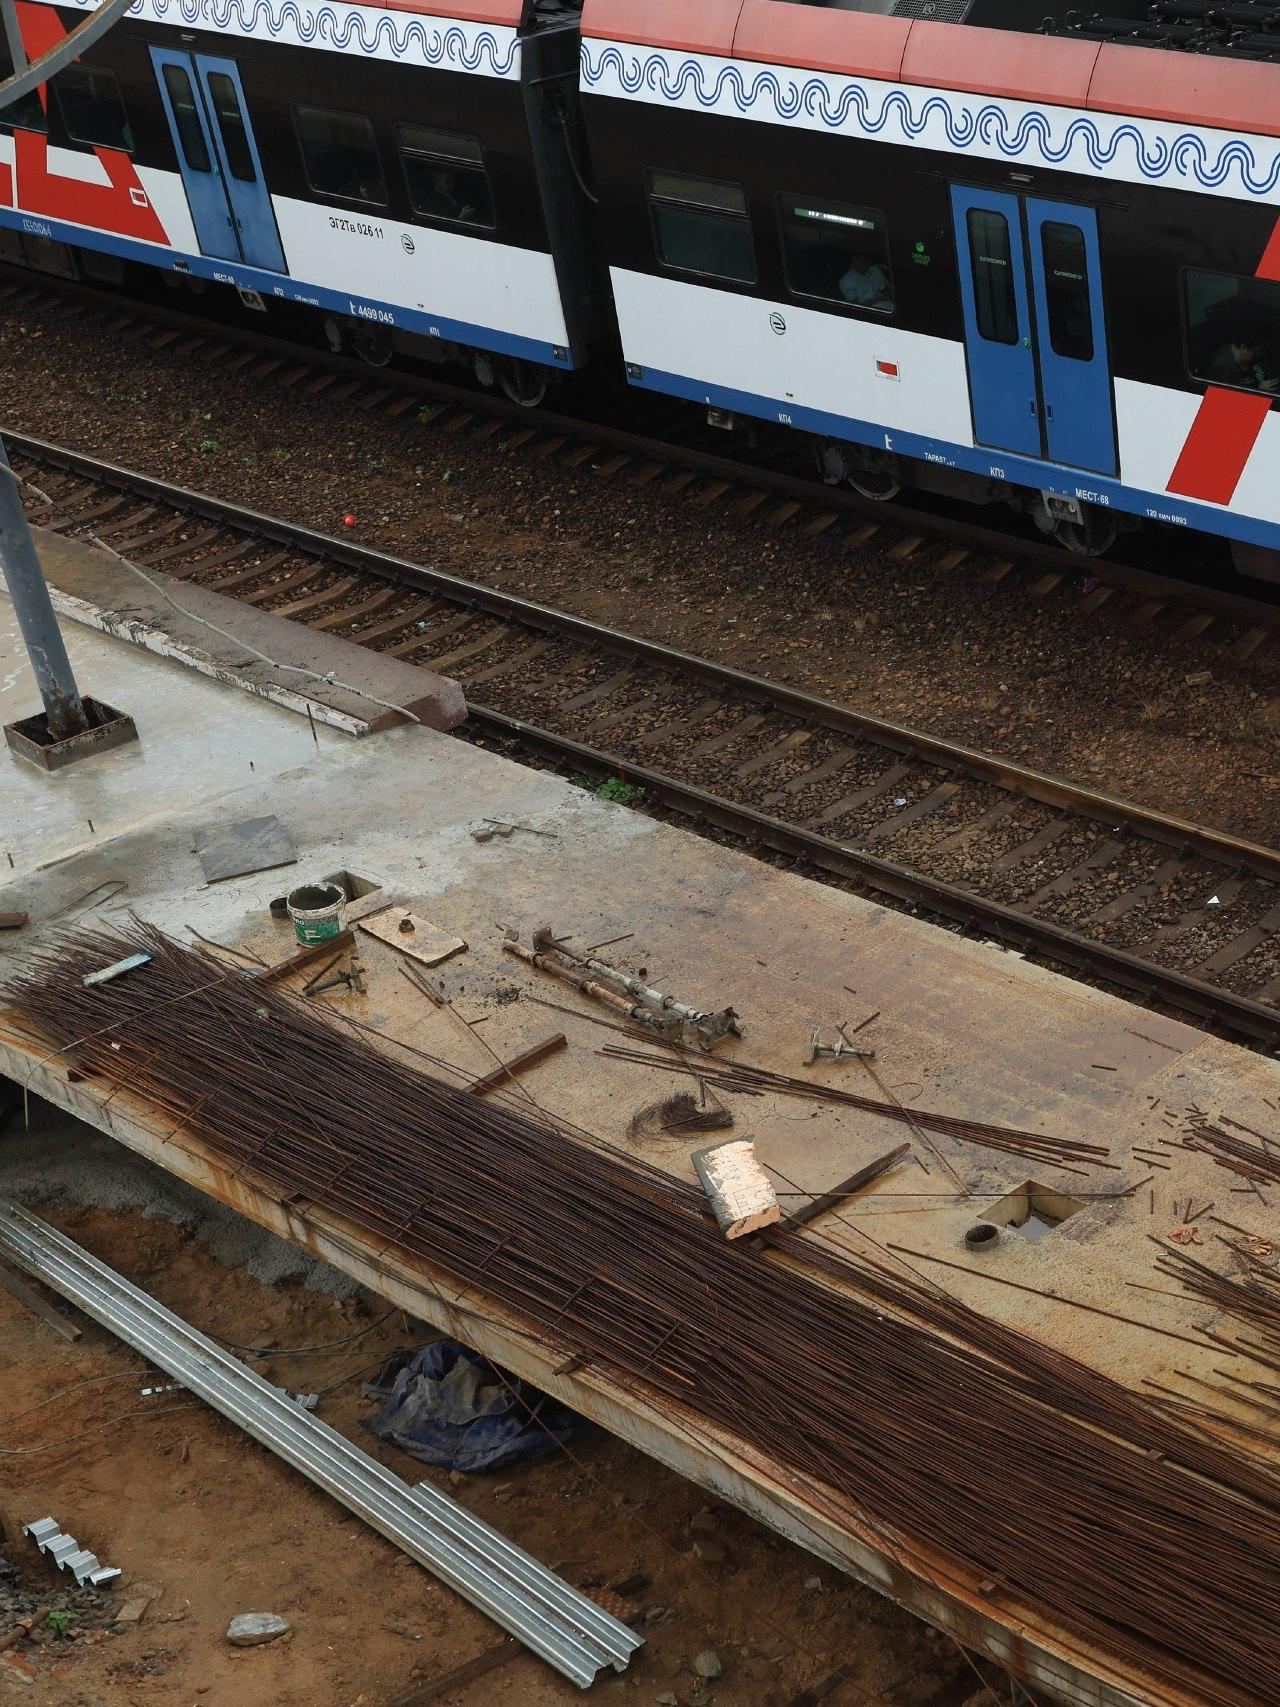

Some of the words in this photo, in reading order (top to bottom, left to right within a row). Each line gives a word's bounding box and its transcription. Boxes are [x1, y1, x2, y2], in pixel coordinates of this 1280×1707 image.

[357, 222, 374, 237] 026
[375, 227, 384, 239] 11
[358, 306, 378, 320] 4499
[379, 310, 395, 324] 045
[778, 412, 792, 425] КП4
[990, 466, 1005, 479] КП3
[1075, 487, 1110, 506] МЕСТ-68
[1146, 508, 1158, 518] 120
